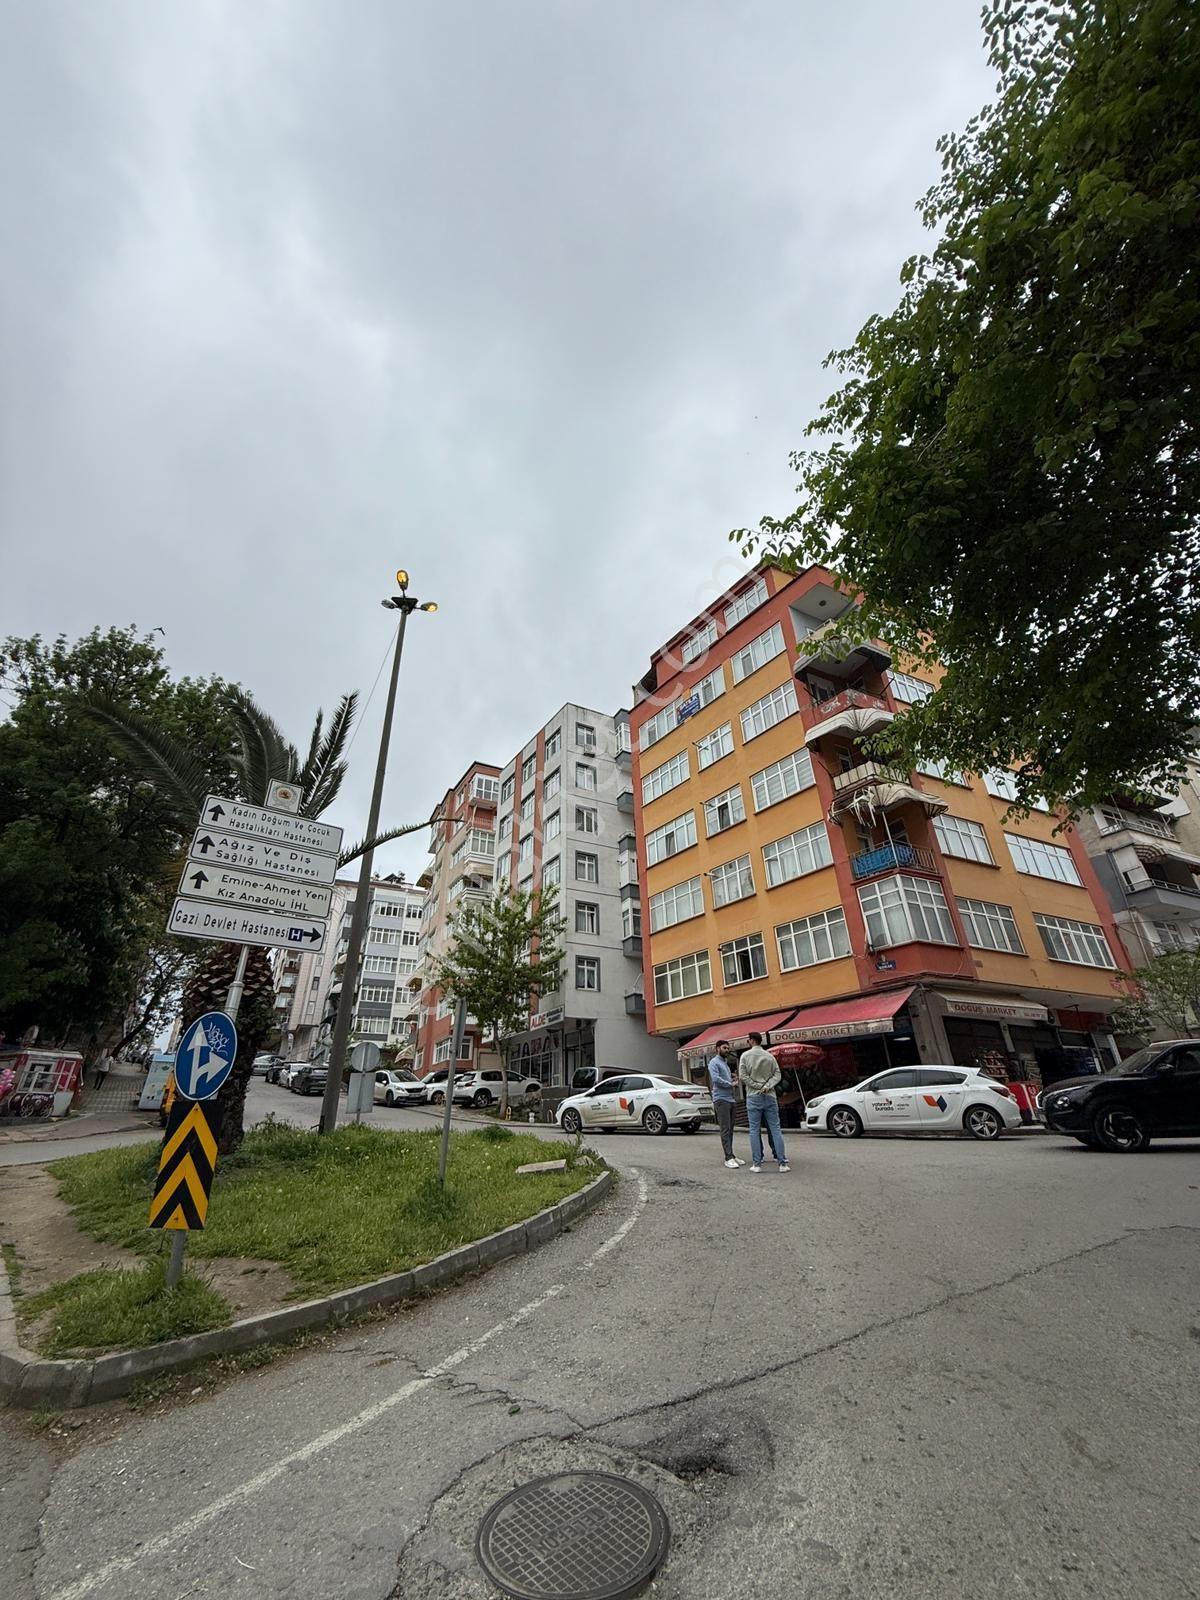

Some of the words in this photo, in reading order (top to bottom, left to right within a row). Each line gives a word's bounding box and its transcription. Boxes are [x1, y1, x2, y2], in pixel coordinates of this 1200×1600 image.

[229, 818, 280, 837] Hastalıkları
[283, 831, 323, 846] Hastanesi
[232, 806, 257, 819] Kadın
[261, 813, 291, 826] Doğum
[294, 821, 304, 831] Ve
[307, 824, 331, 837] Çocuk
[216, 849, 259, 866] Sağlığı
[264, 859, 320, 877] Hastanesi
[219, 838, 255, 852] Ağız
[263, 847, 281, 857] Ve
[289, 852, 312, 864] Diş
[217, 887, 235, 899] Kız
[238, 892, 286, 908] Anadolu
[290, 899, 309, 912] İHL
[221, 874, 301, 897] Emine-Ahmet
[305, 889, 328, 902] Yeni
[175, 910, 199, 925] Gazi
[203, 914, 237, 931] Devlet
[241, 919, 290, 939] Hastanesi
[289, 928, 302, 941] H
[986, 1006, 1017, 1015] MARKET
[811, 1027, 851, 1037] MARKET
[537, 1506, 608, 1556] TELEFON
